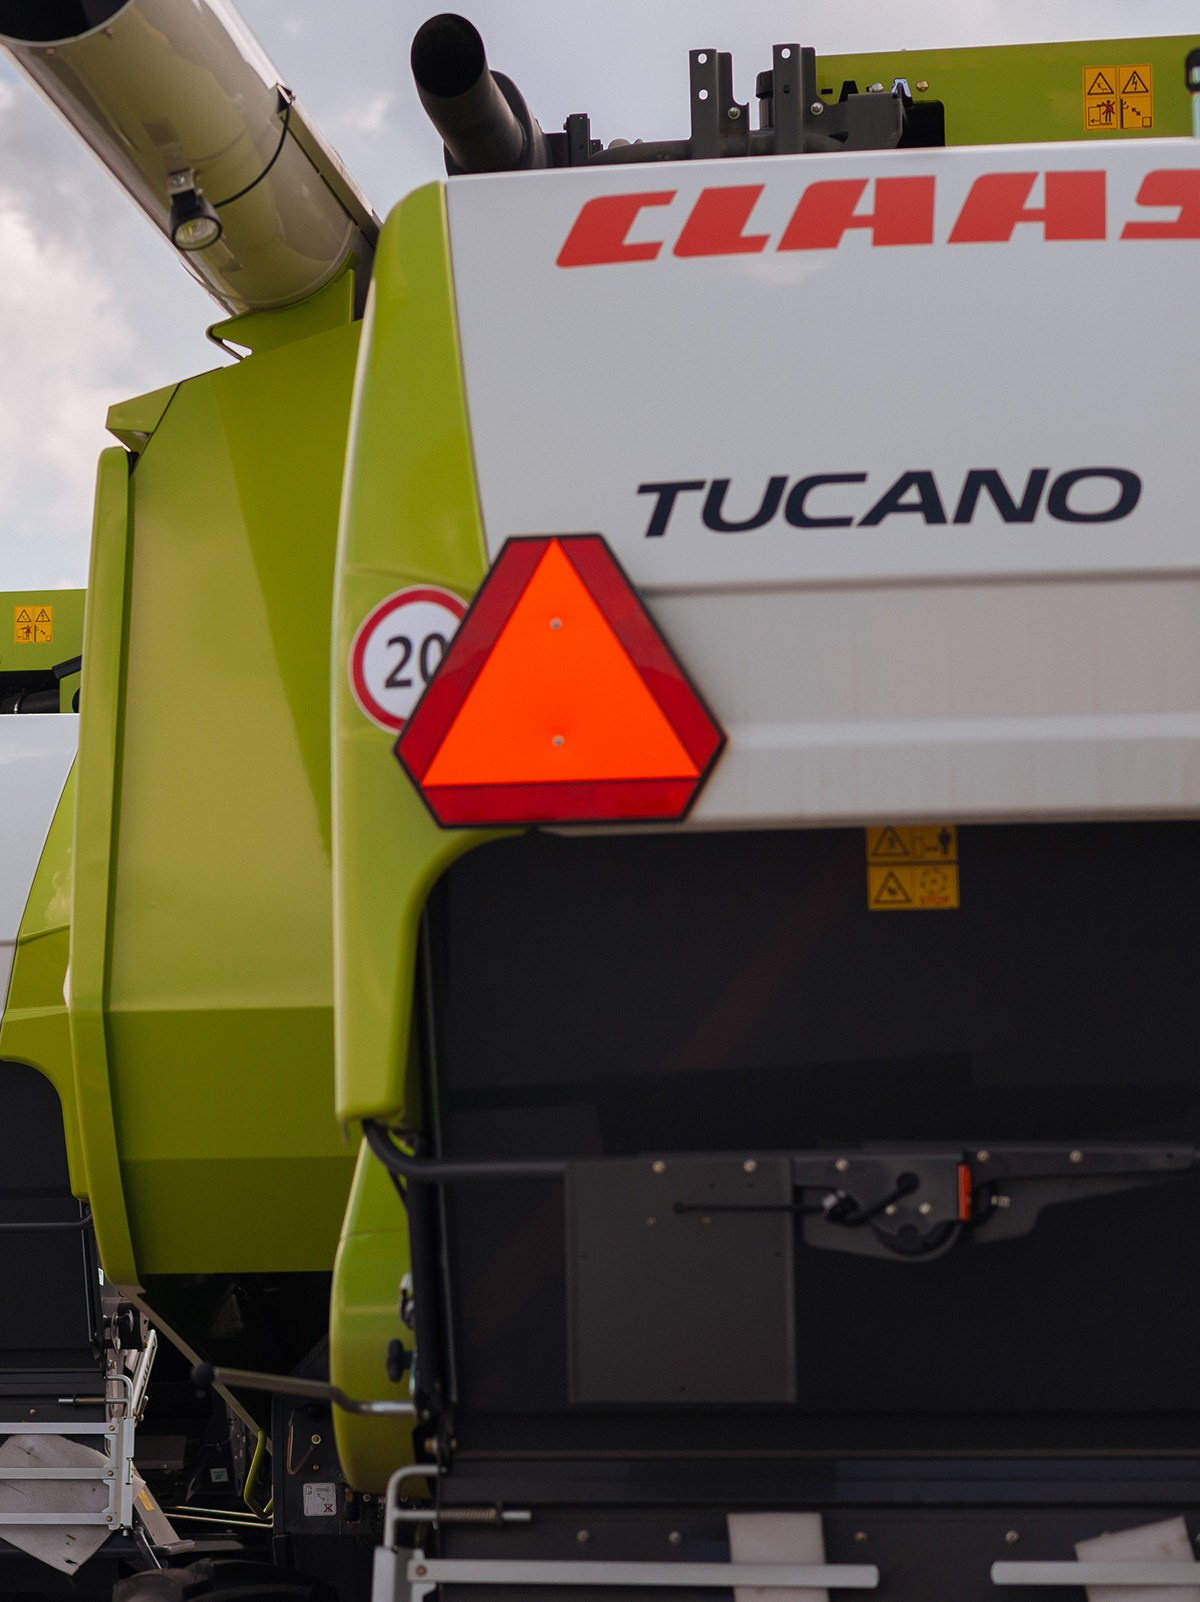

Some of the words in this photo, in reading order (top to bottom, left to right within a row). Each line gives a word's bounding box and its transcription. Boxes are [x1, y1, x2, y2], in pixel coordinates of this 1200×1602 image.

[556, 168, 1200, 269] CLAAS
[636, 466, 1142, 538] TUCANO
[385, 632, 452, 690] 20
